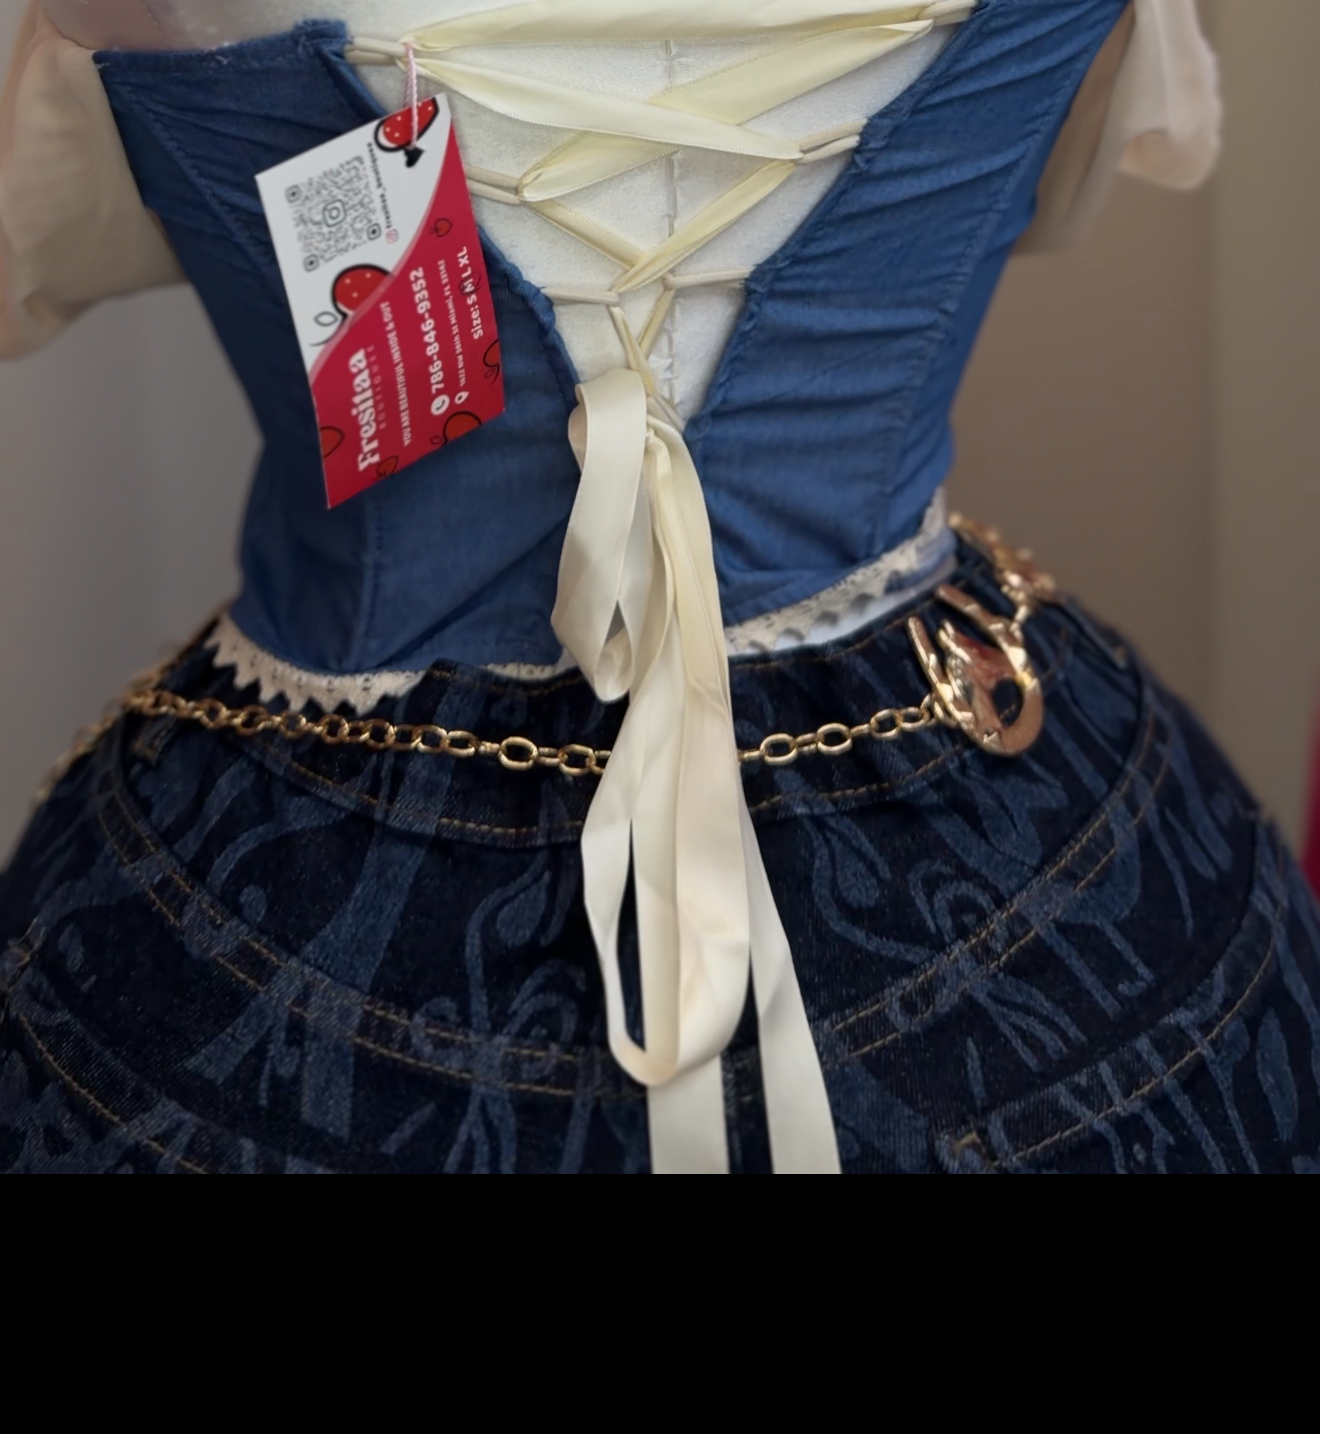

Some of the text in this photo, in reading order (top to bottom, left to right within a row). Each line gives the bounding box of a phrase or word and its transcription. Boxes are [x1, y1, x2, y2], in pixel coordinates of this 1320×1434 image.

[409, 266, 445, 394] 786-846-9352
[444, 284, 451, 296] FL
[445, 295, 457, 325] Miami,
[457, 246, 484, 340] Size: S M L XL
[380, 301, 412, 446] YOU ARE BEAUTIFUL INSIDE & OUT
[457, 354, 464, 369] NW
[348, 348, 381, 472] Fresitaa
